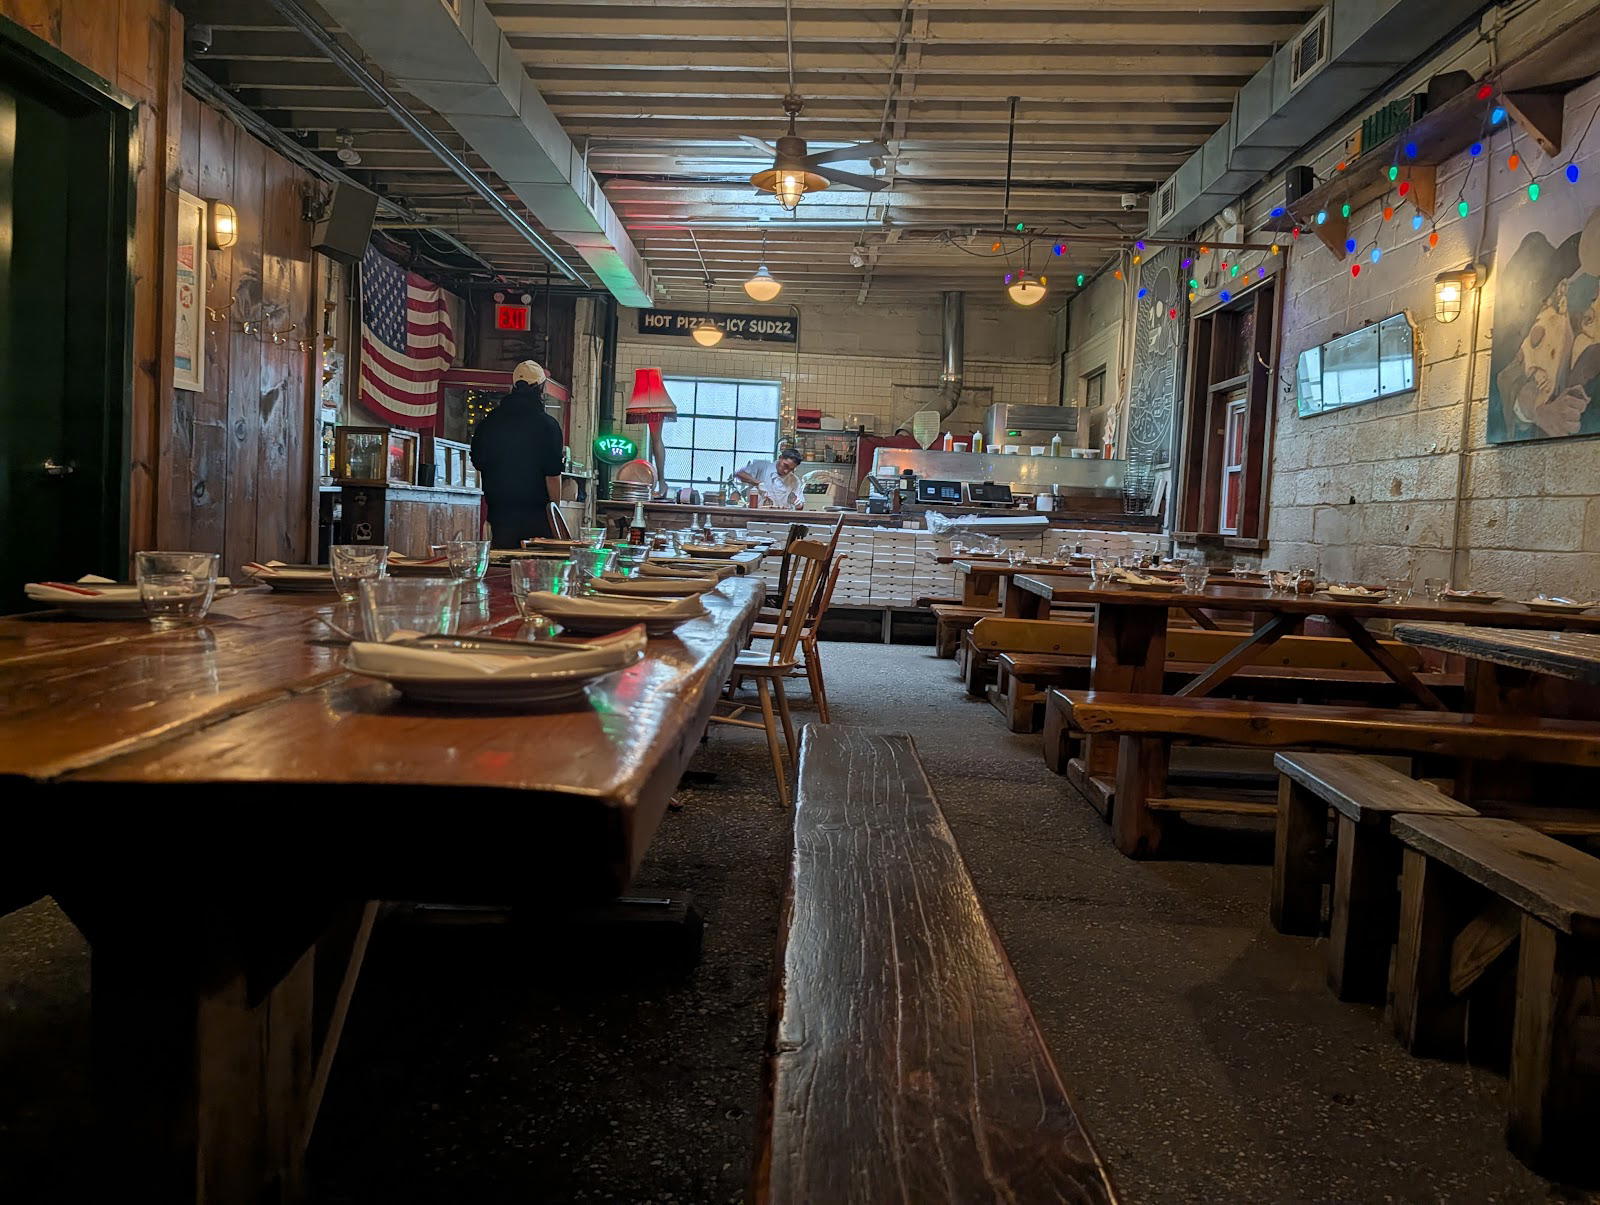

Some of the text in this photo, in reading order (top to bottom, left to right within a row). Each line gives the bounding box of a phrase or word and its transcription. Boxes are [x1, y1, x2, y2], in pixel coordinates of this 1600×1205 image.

[499, 308, 528, 329] EXIT
[645, 314, 672, 327] HOT
[726, 318, 746, 331] ICY
[599, 438, 632, 453] PIZZA
